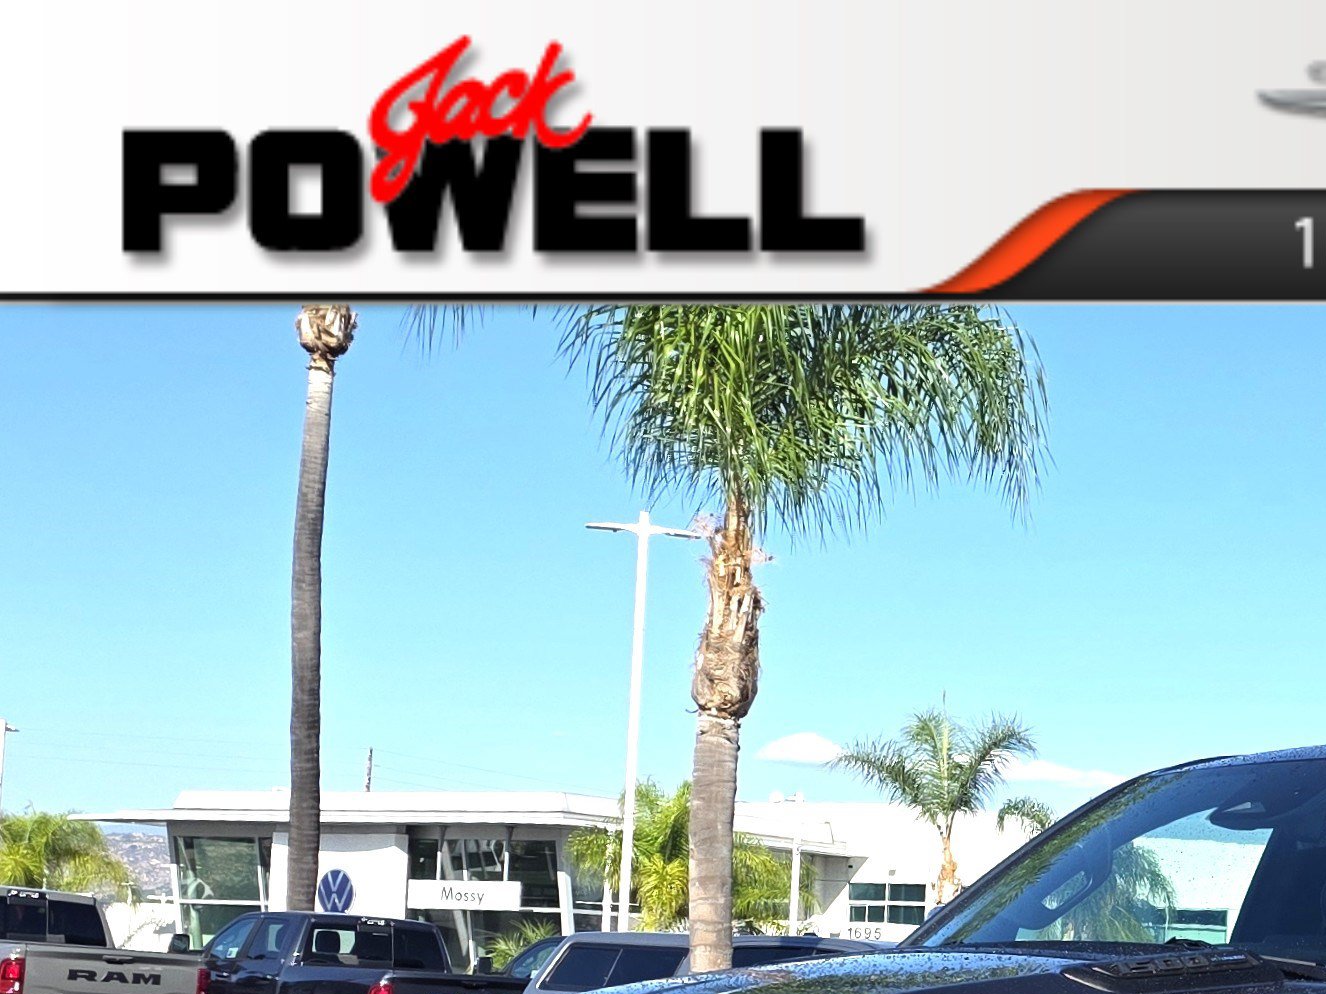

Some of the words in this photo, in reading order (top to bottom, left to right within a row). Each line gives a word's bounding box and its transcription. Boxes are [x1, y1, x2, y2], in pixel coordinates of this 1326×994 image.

[440, 886, 485, 905] Mossy
[847, 927, 882, 940] 1695
[66, 968, 162, 986] RAM
